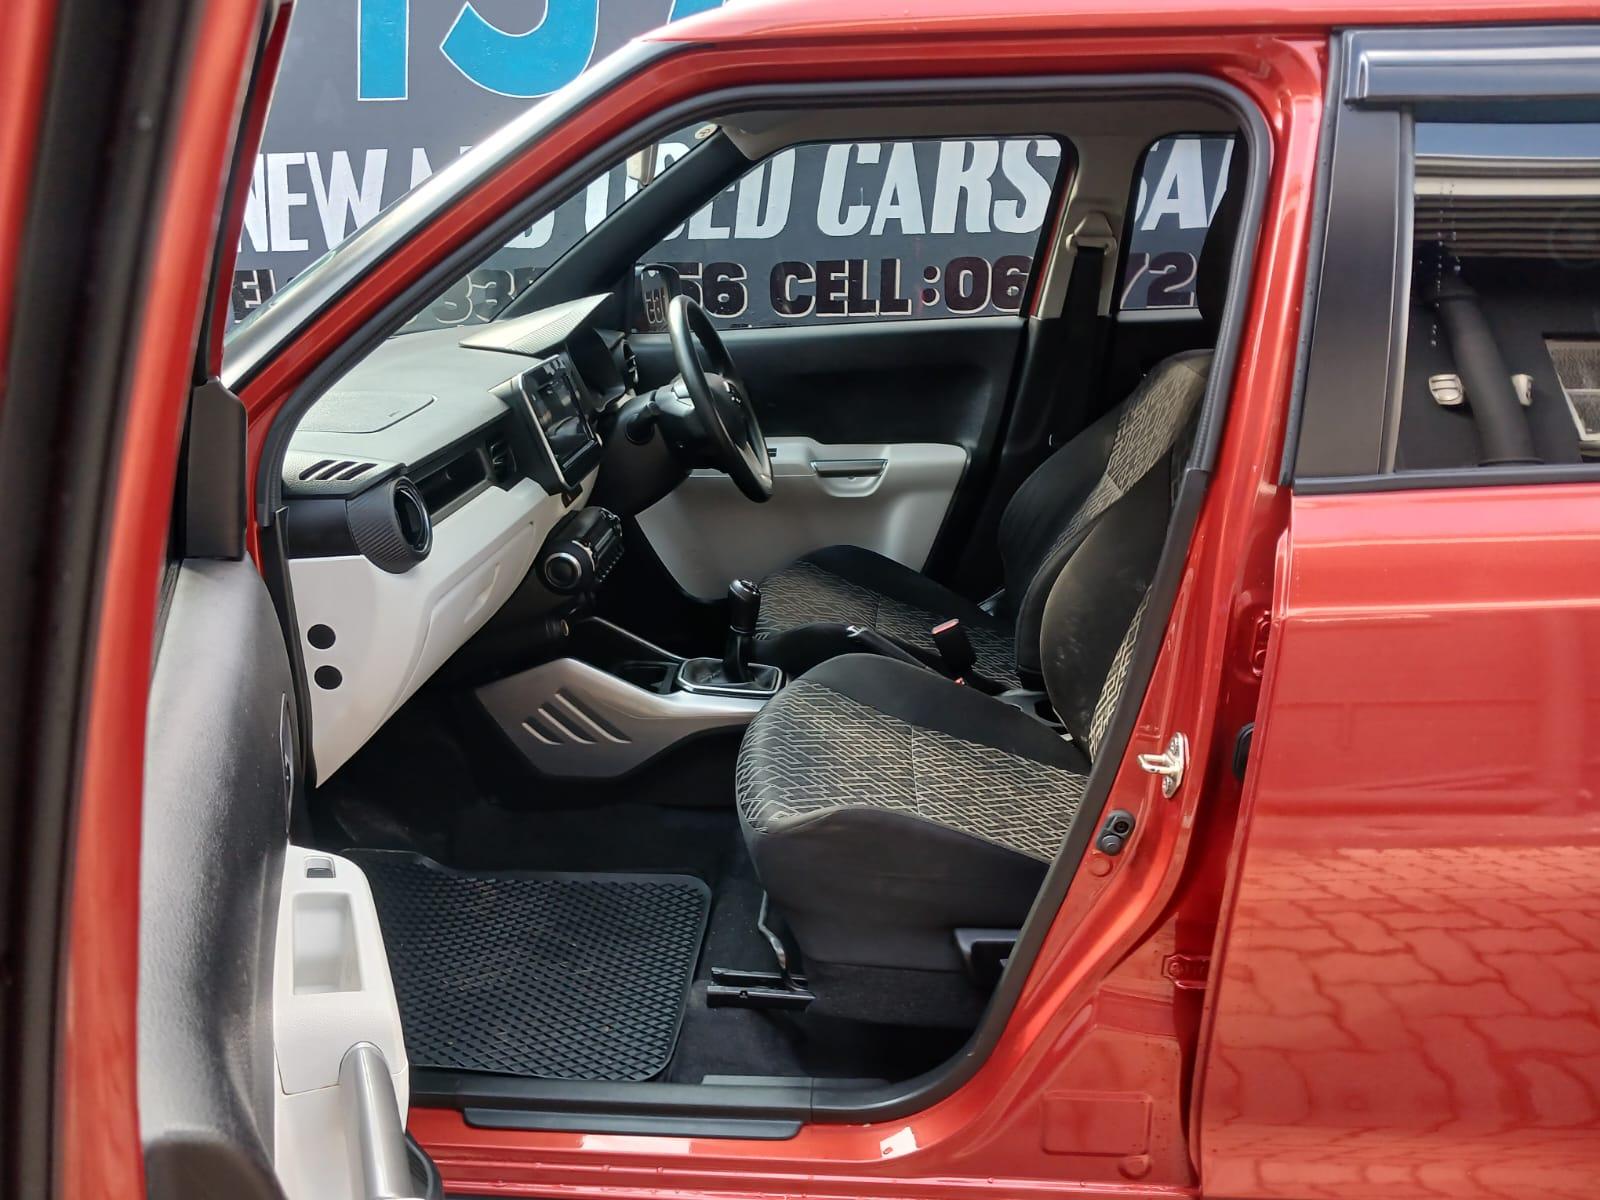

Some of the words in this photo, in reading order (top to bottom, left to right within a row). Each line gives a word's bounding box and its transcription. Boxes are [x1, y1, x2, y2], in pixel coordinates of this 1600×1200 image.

[237, 149, 388, 252] NEW
[816, 139, 1061, 237] CARS
[769, 258, 912, 318] CELL
